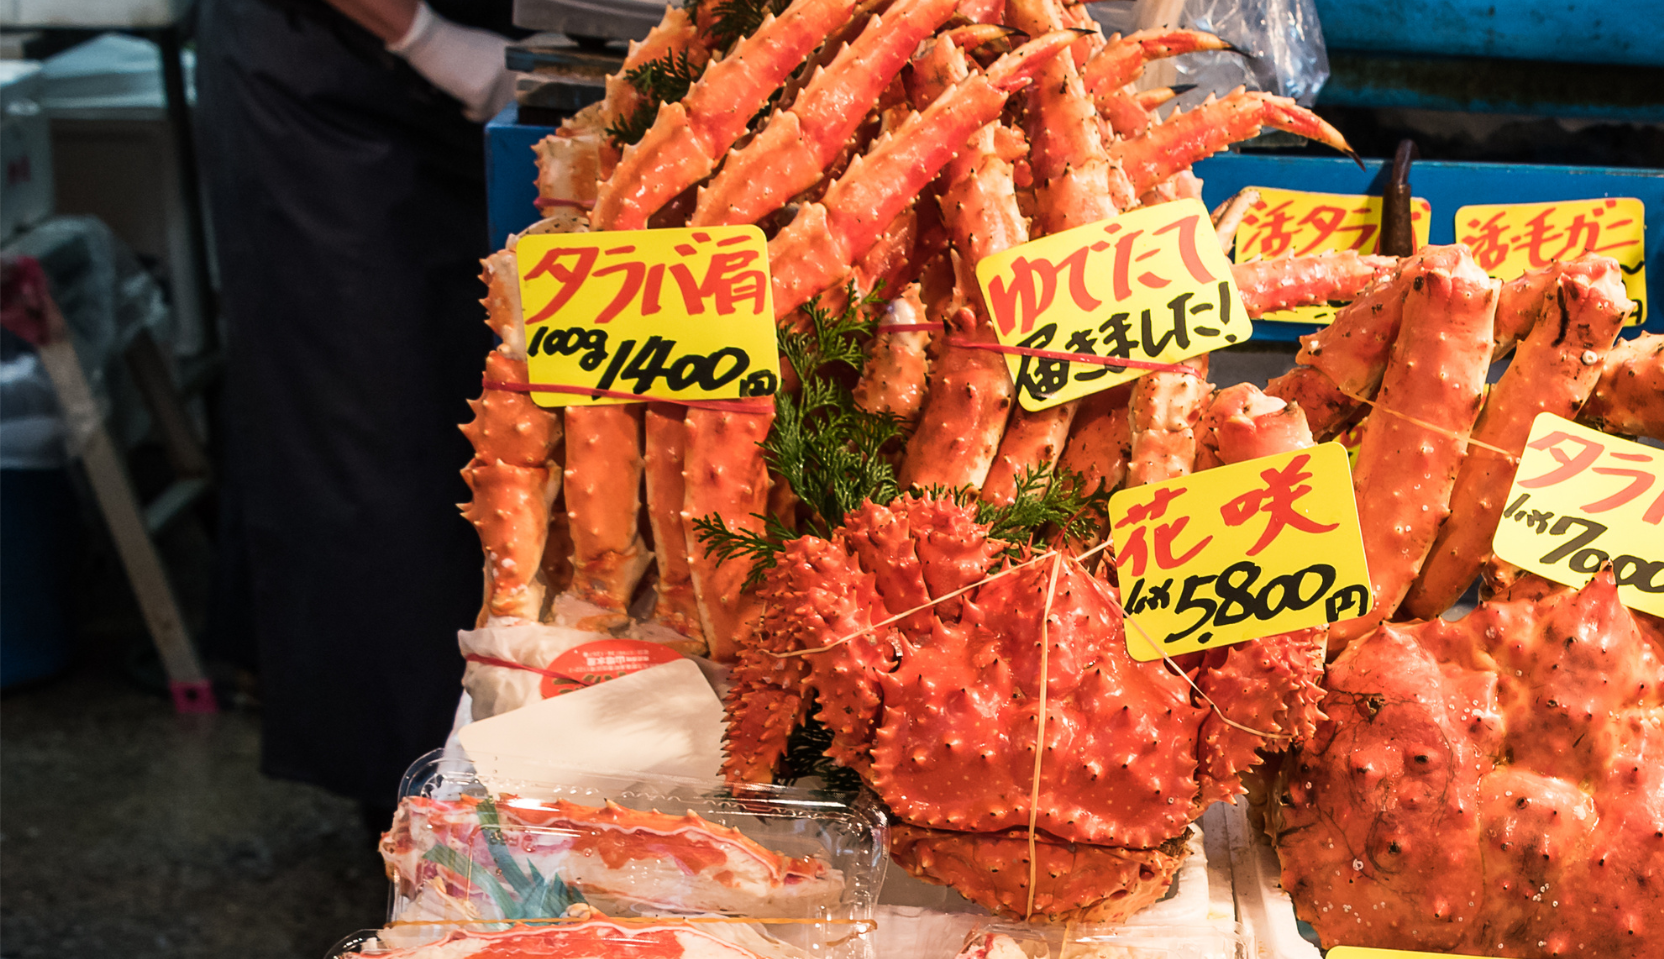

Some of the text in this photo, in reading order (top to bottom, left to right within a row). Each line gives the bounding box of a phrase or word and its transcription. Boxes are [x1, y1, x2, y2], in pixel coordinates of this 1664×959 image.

[523, 232, 767, 325] タラバ肩
[988, 214, 1217, 337] ゆでたて
[1242, 200, 1431, 257] 活タラ
[1015, 281, 1238, 402] 届きました!
[1114, 453, 1341, 577] 花咲
